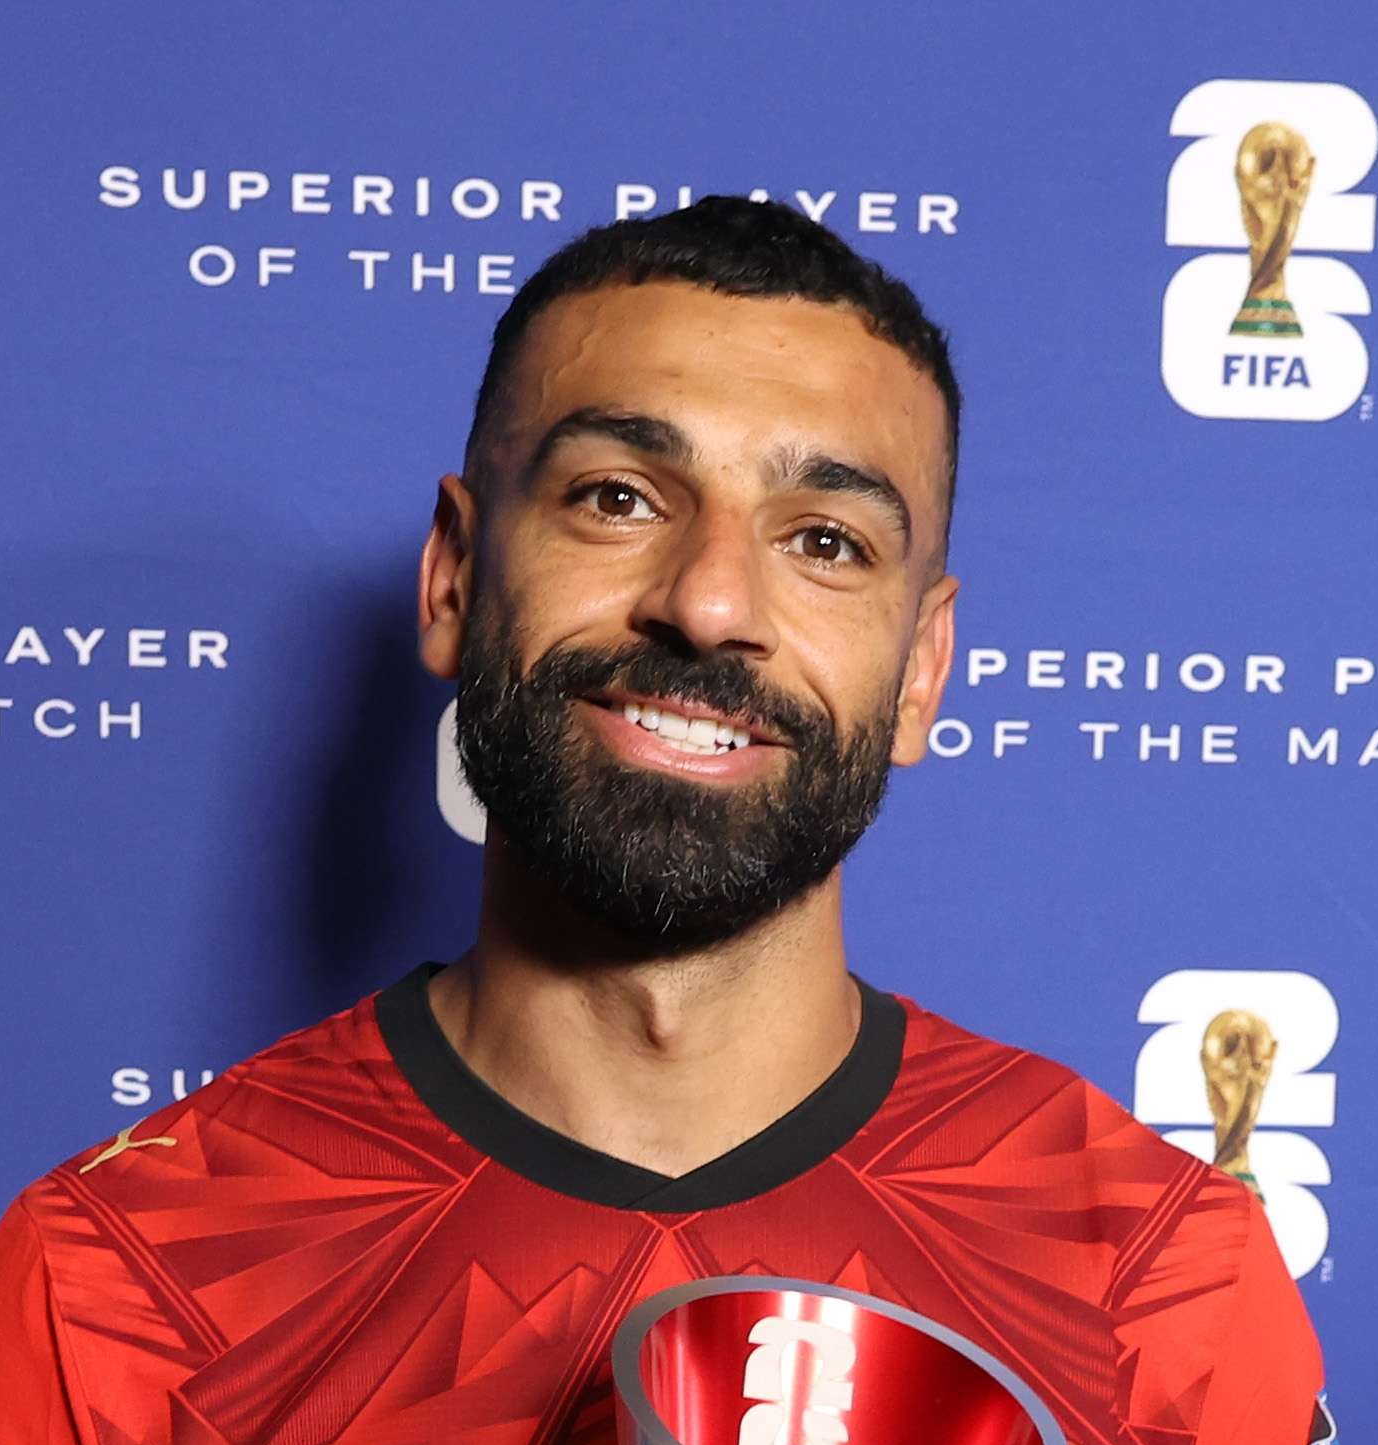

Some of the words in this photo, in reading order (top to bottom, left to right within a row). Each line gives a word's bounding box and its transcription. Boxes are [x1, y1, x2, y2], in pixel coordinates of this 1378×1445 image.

[99, 166, 563, 222] SUPERIOR
[188, 245, 296, 287] OF
[347, 250, 516, 295] THE
[1223, 354, 1310, 388] FIFA
[967, 648, 1286, 694] PERIOR
[928, 718, 1031, 759] OF
[1078, 722, 1238, 763] THE
